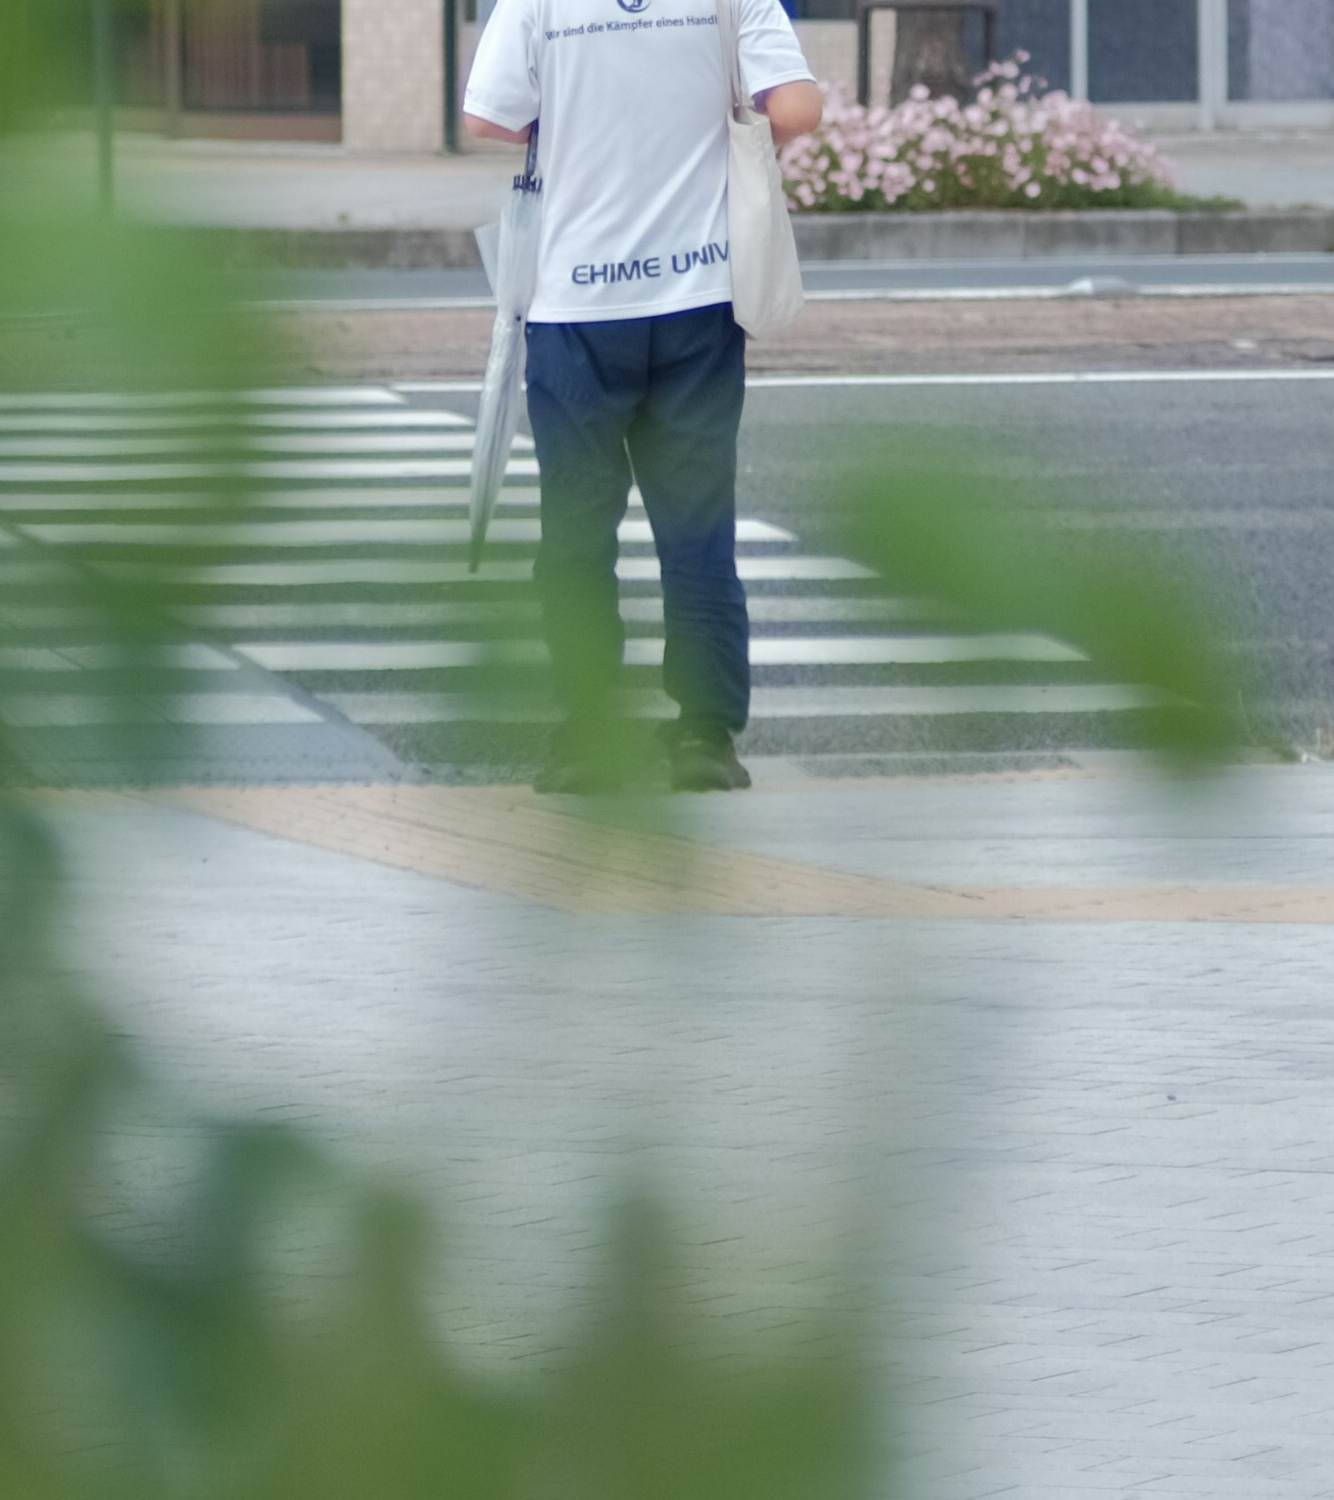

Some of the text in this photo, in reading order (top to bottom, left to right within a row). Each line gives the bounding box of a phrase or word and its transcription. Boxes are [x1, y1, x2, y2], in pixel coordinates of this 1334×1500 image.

[563, 23, 585, 38] sind
[587, 21, 604, 33] die
[606, 19, 653, 32] Kämpfer
[656, 16, 684, 28] eines
[687, 14, 719, 26] Hand
[571, 256, 662, 286] EHIME
